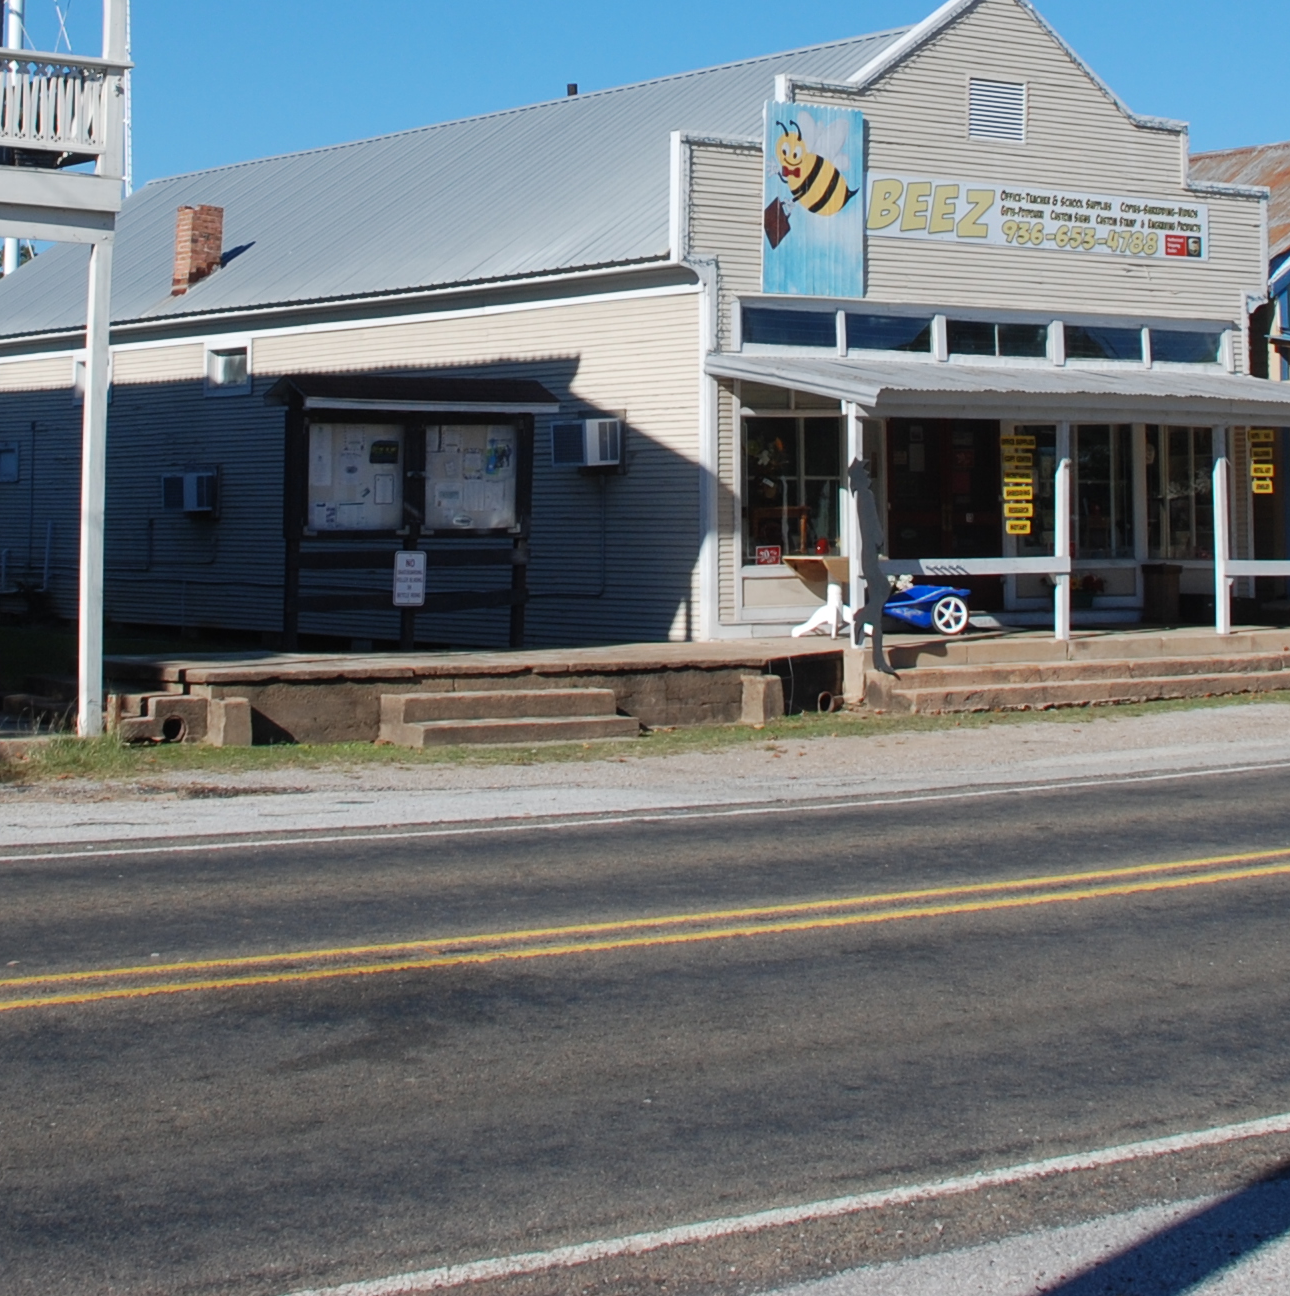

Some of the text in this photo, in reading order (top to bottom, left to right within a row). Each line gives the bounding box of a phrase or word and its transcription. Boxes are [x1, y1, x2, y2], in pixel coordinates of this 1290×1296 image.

[866, 178, 996, 238] BEEZ
[1052, 195, 1058, 206] &
[1001, 219, 1158, 255] 936-653-4788
[406, 559, 415, 567] NO
